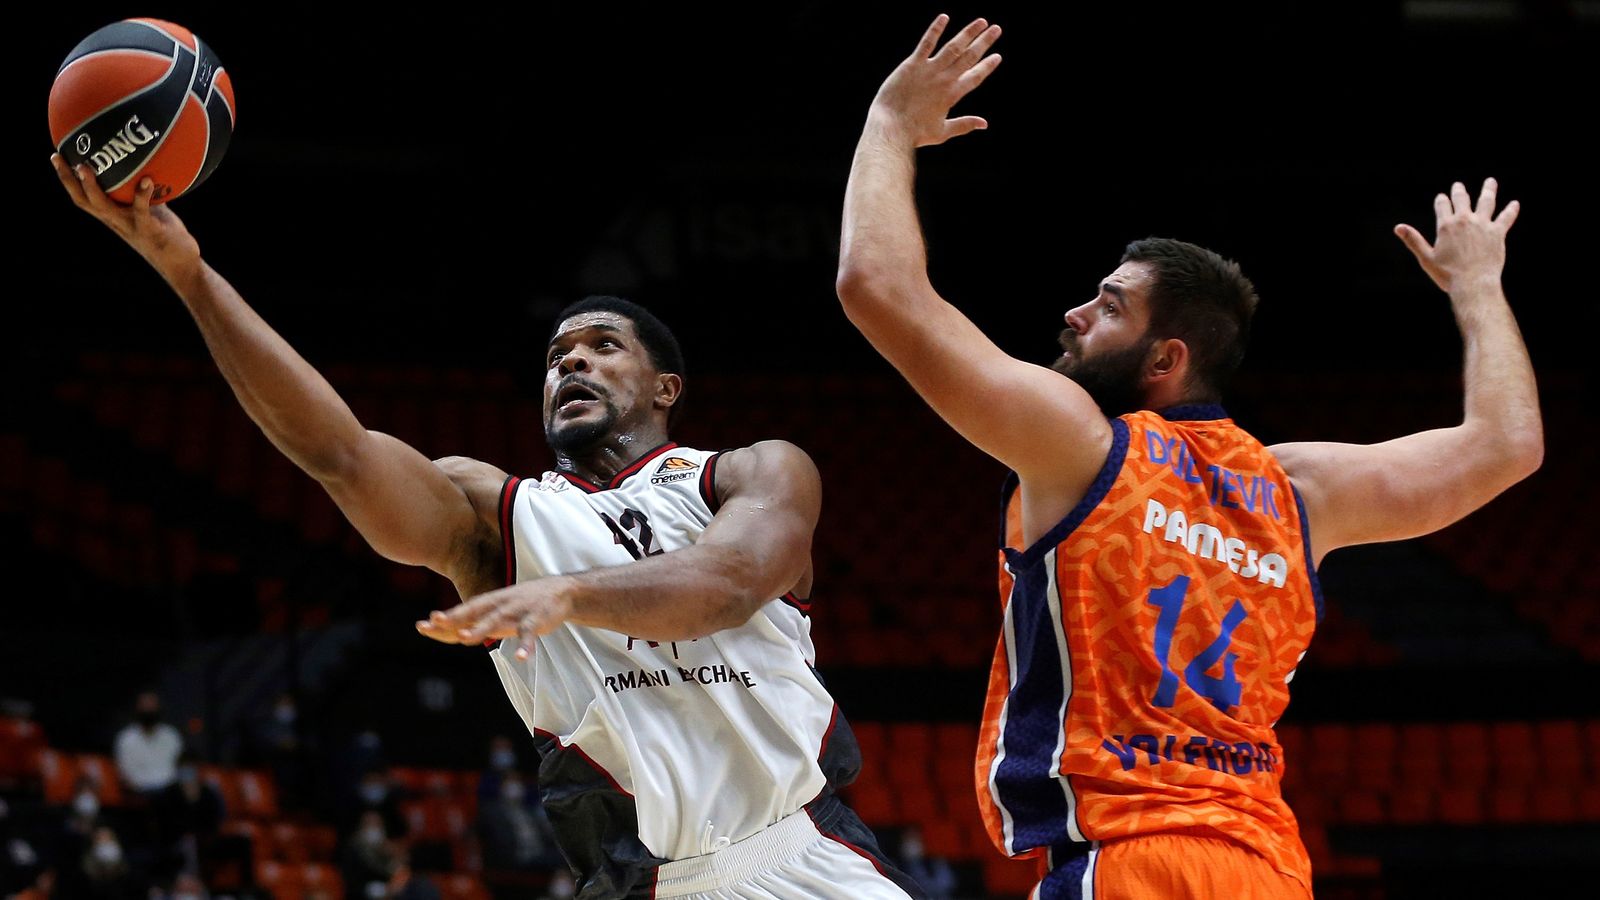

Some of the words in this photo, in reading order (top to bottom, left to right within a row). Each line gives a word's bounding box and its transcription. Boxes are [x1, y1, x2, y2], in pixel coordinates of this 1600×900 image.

[651, 471, 696, 485] oneteam
[1143, 498, 1288, 589] PAMESA
[1147, 574, 1248, 713] 14
[604, 668, 671, 694] RMANI
